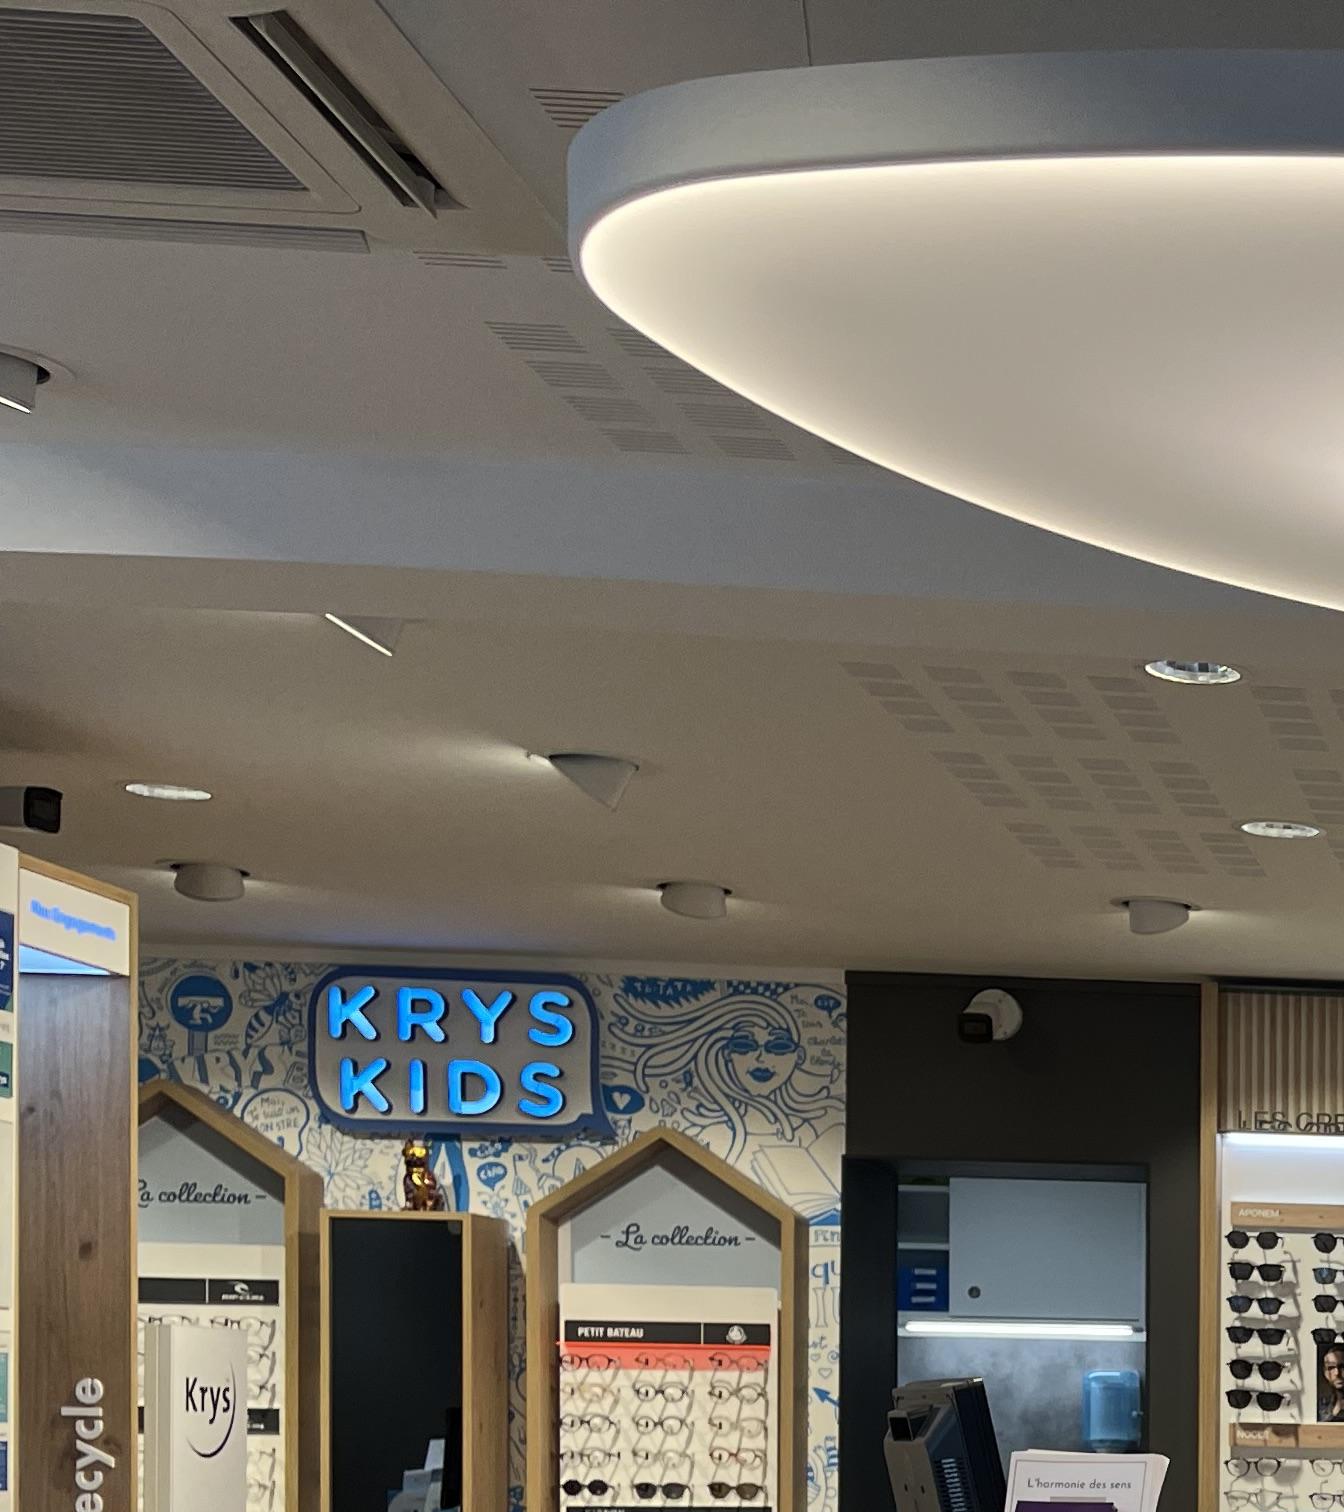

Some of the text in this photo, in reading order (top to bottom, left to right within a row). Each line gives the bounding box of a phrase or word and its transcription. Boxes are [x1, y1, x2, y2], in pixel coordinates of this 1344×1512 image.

[327, 985, 573, 1046] KRYS
[340, 1057, 563, 1117] KIDS
[1238, 1110, 1287, 1131] LES
[158, 1182, 252, 1205] collection
[616, 1222, 741, 1250] La collection
[577, 1326, 644, 1339] PETIT BATEAU
[185, 1376, 231, 1424] Krys
[1027, 1478, 1132, 1490] L'harmonie des sens
